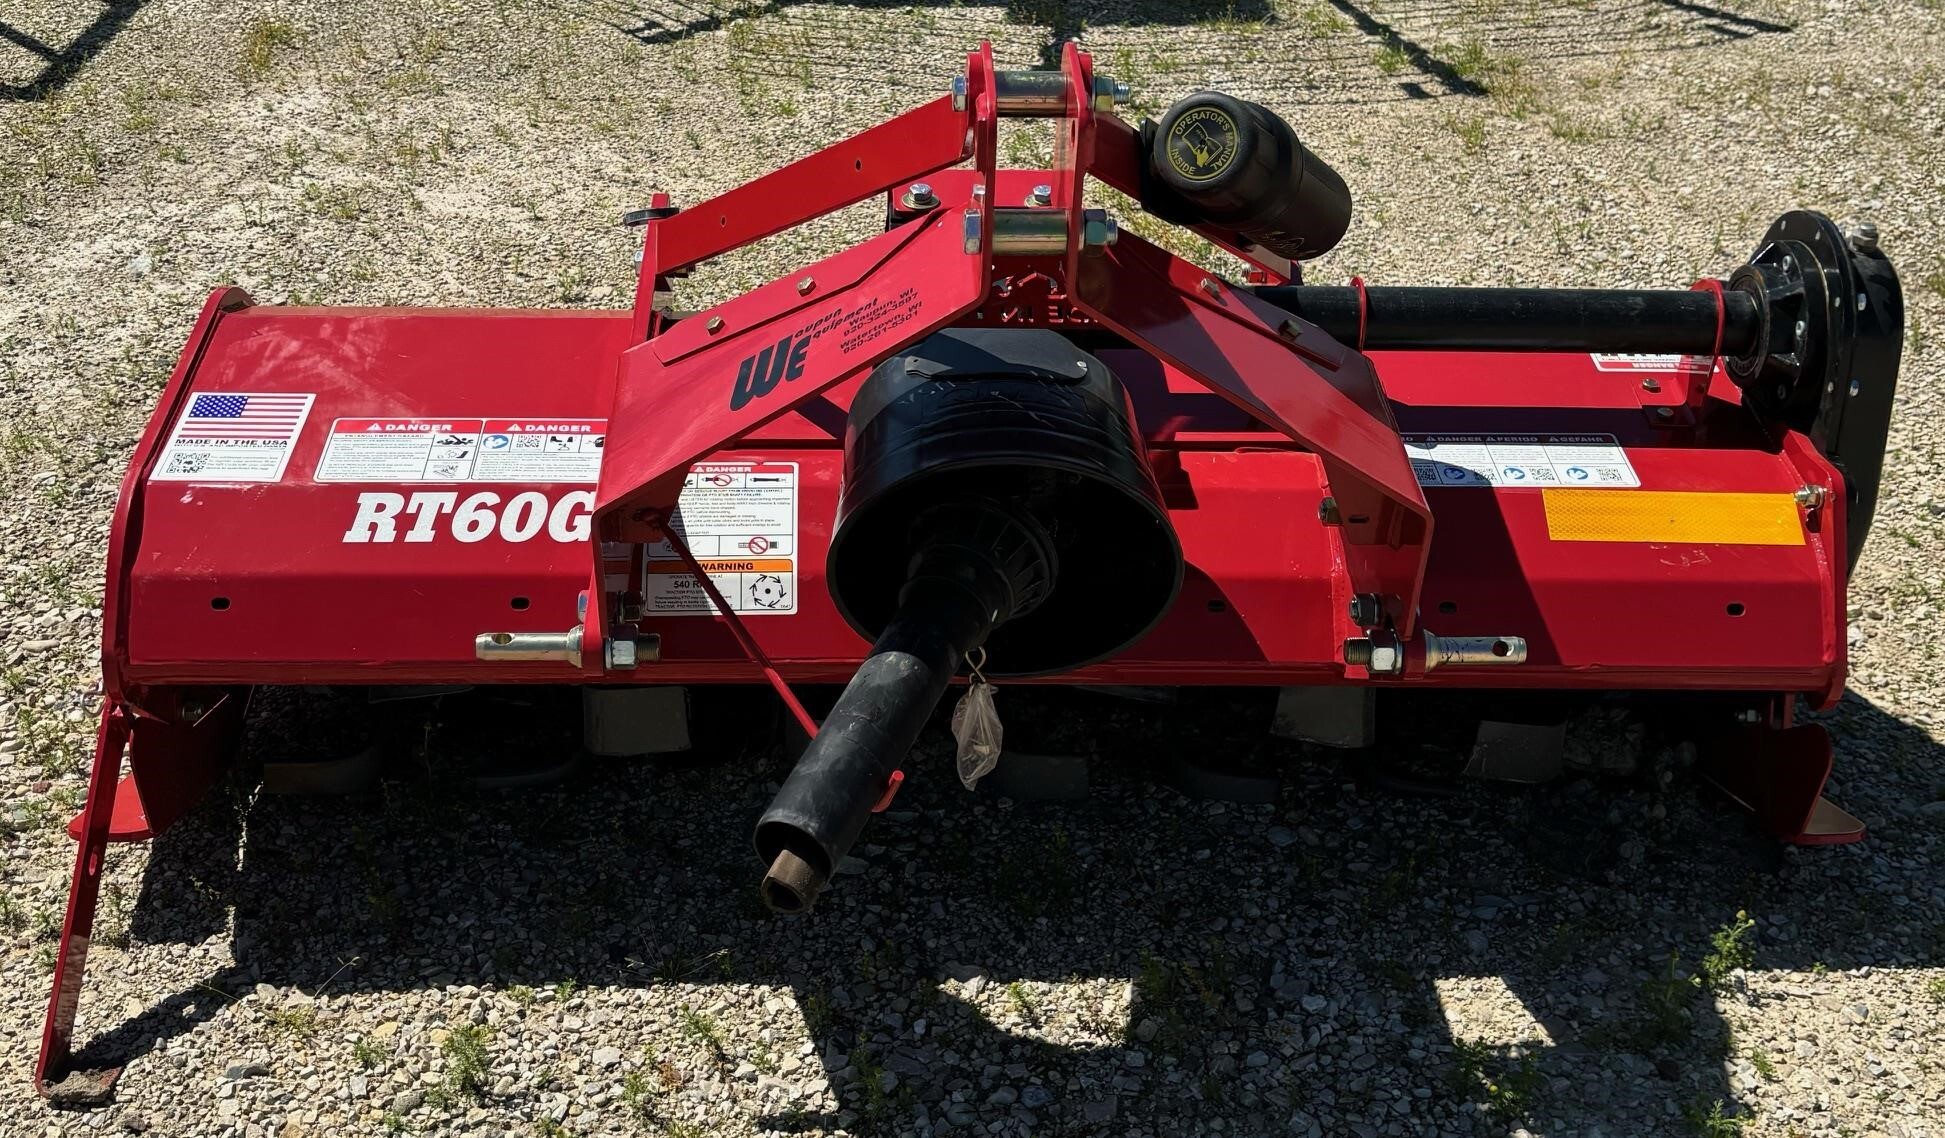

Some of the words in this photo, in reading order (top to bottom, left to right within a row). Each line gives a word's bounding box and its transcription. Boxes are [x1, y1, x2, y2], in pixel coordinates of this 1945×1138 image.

[1175, 111, 1230, 135] OPERATOR'S
[1210, 132, 1234, 170] MANUAL
[1171, 148, 1197, 175] INSIDE
[342, 490, 597, 543] RT60G
[700, 563, 753, 571] WARNING
